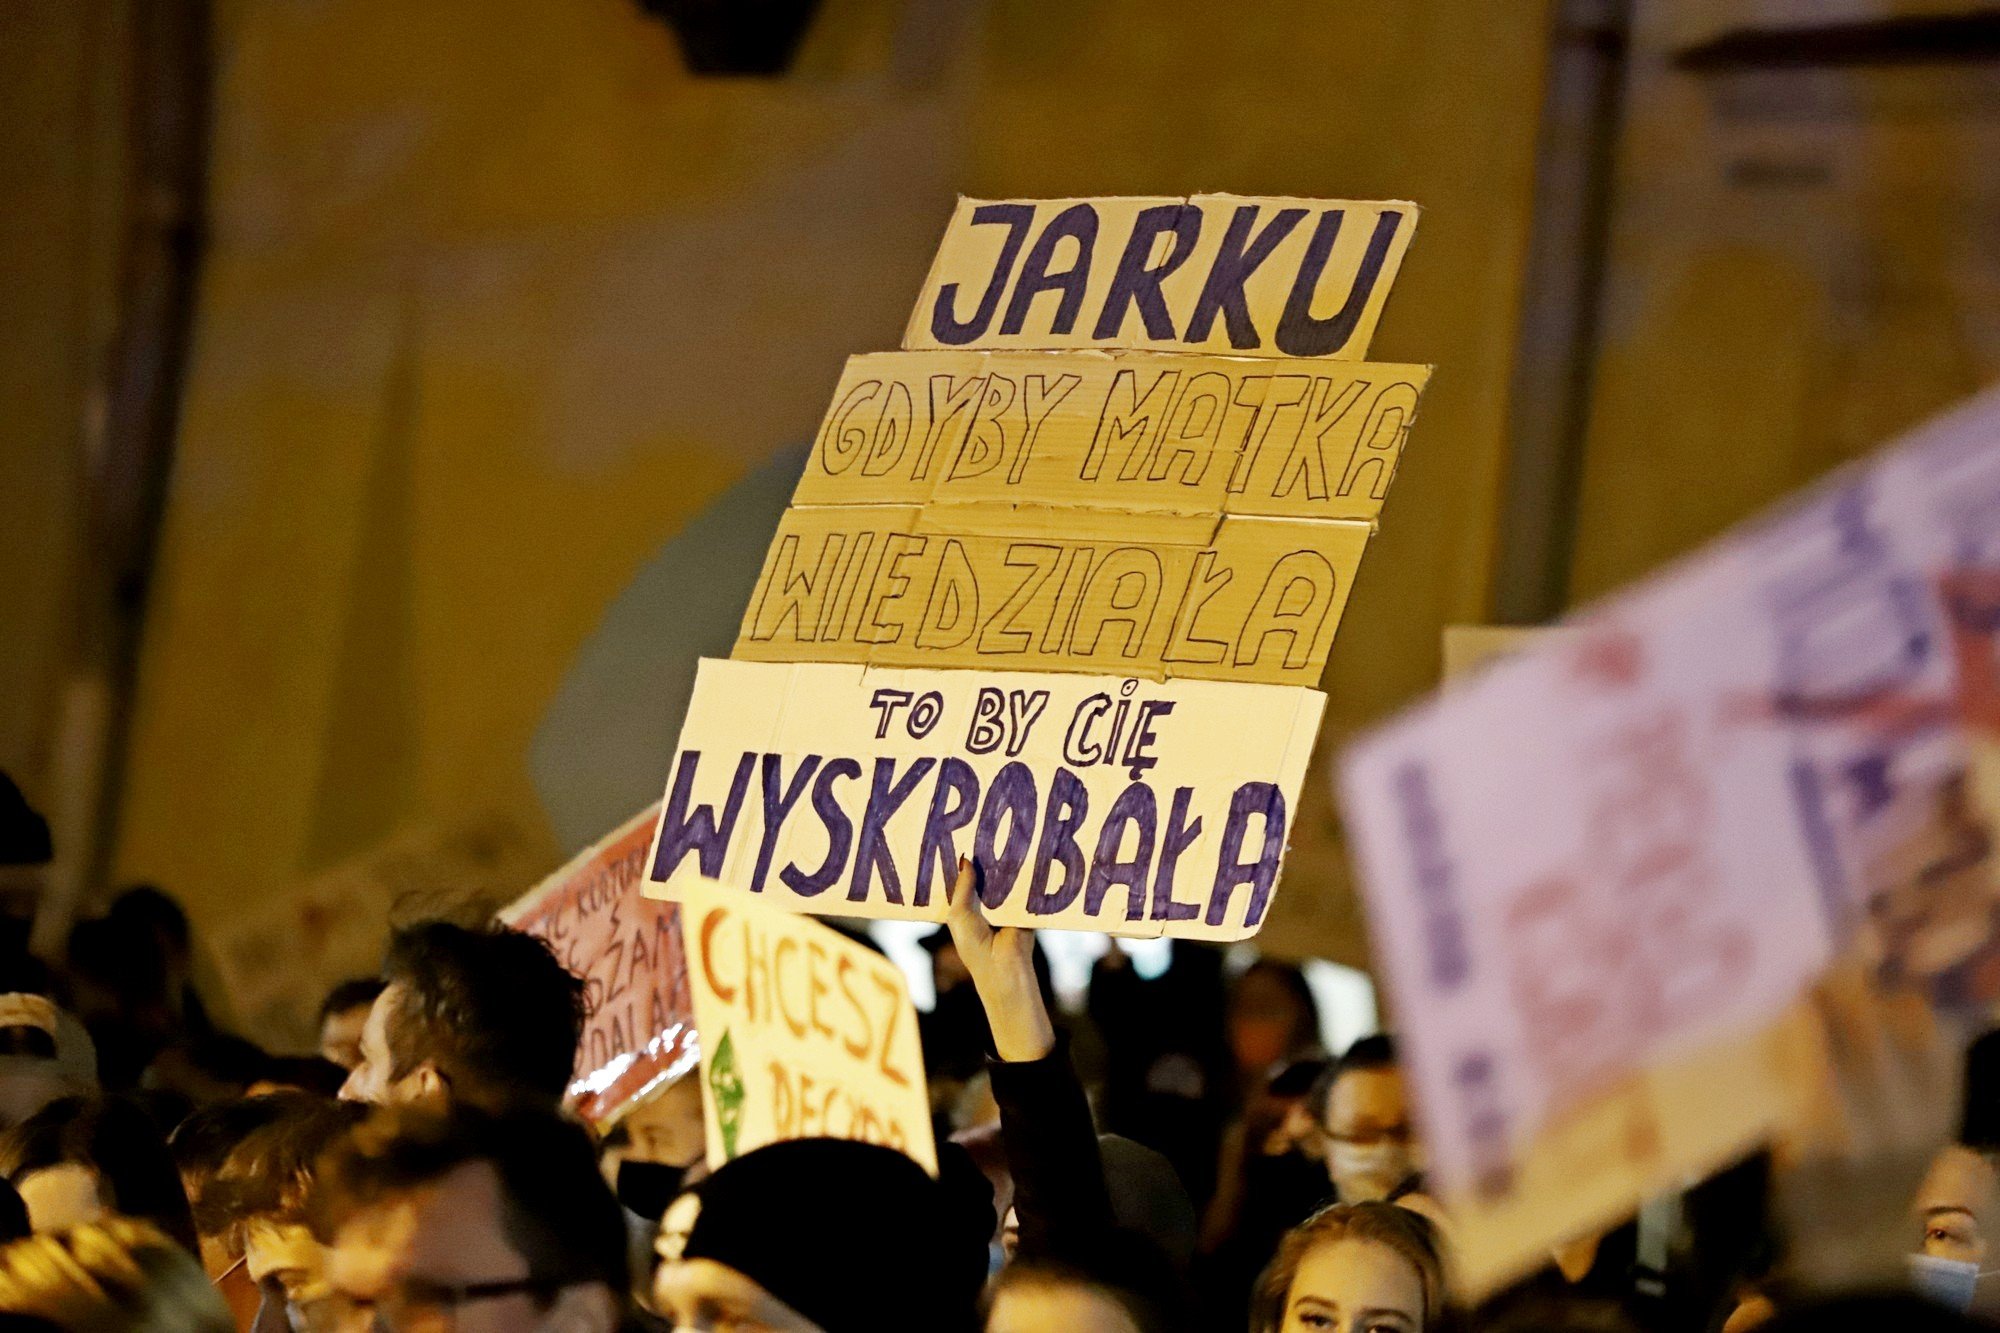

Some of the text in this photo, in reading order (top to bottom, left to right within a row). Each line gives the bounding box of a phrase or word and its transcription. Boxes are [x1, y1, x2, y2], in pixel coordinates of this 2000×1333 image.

[930, 203, 1403, 357] JARKU
[820, 368, 1421, 502] GDYBY MATKA
[750, 530, 1337, 670] WIEDZIAŁA
[869, 679, 1176, 779] TO BY CIĘ
[649, 750, 1287, 928] WYSKROBAŁA
[700, 906, 910, 1088] CHCESZ
